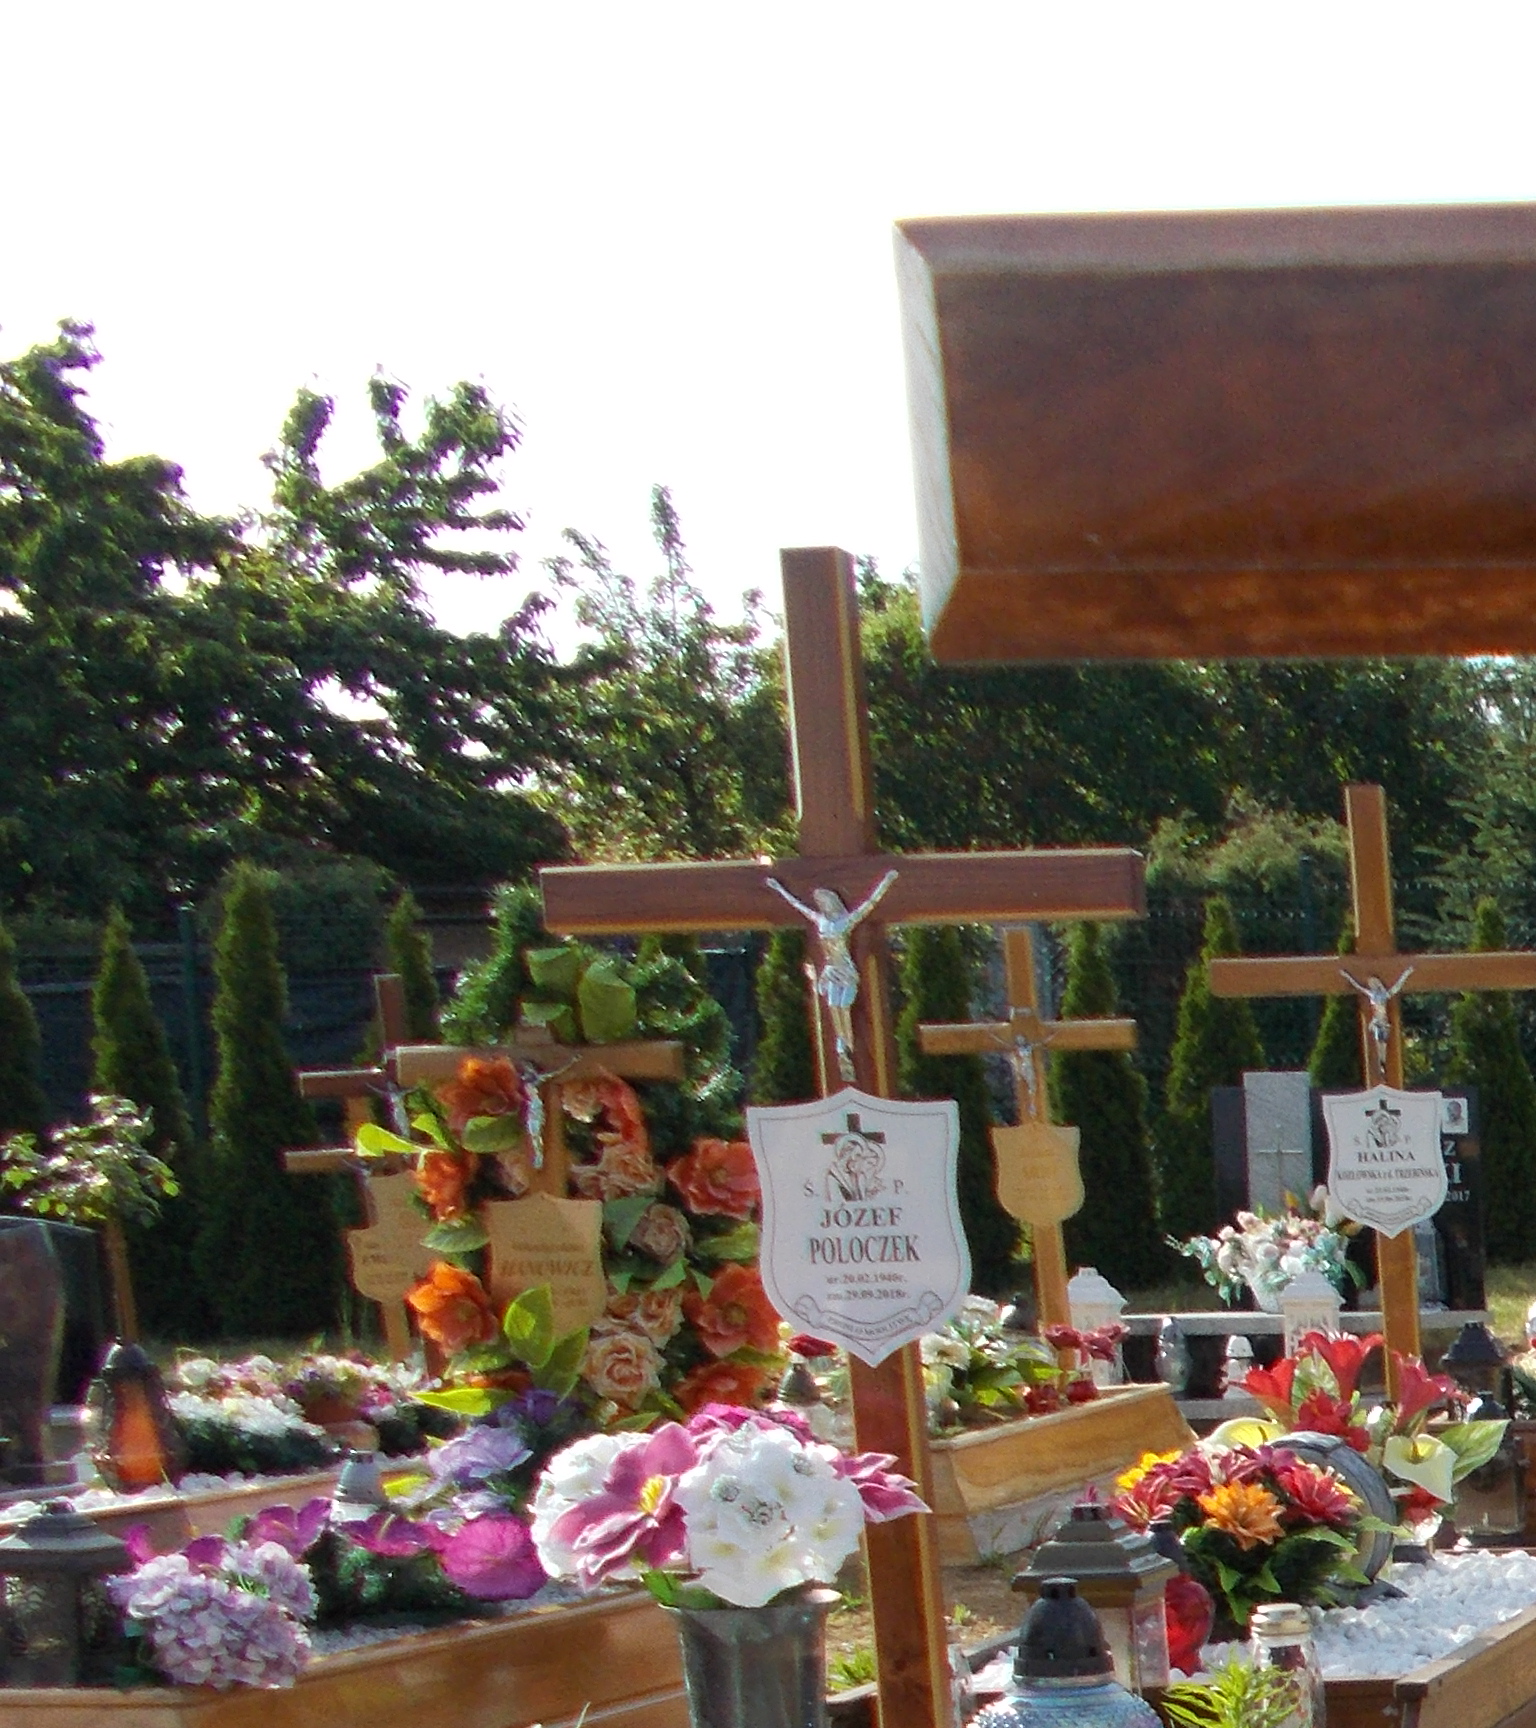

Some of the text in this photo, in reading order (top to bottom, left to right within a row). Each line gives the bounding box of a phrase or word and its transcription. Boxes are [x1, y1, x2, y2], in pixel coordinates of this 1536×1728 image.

[1357, 1151, 1416, 1163] HALINA
[819, 1202, 903, 1229] JÓZEF
[809, 1234, 921, 1264] POLOCZEK
